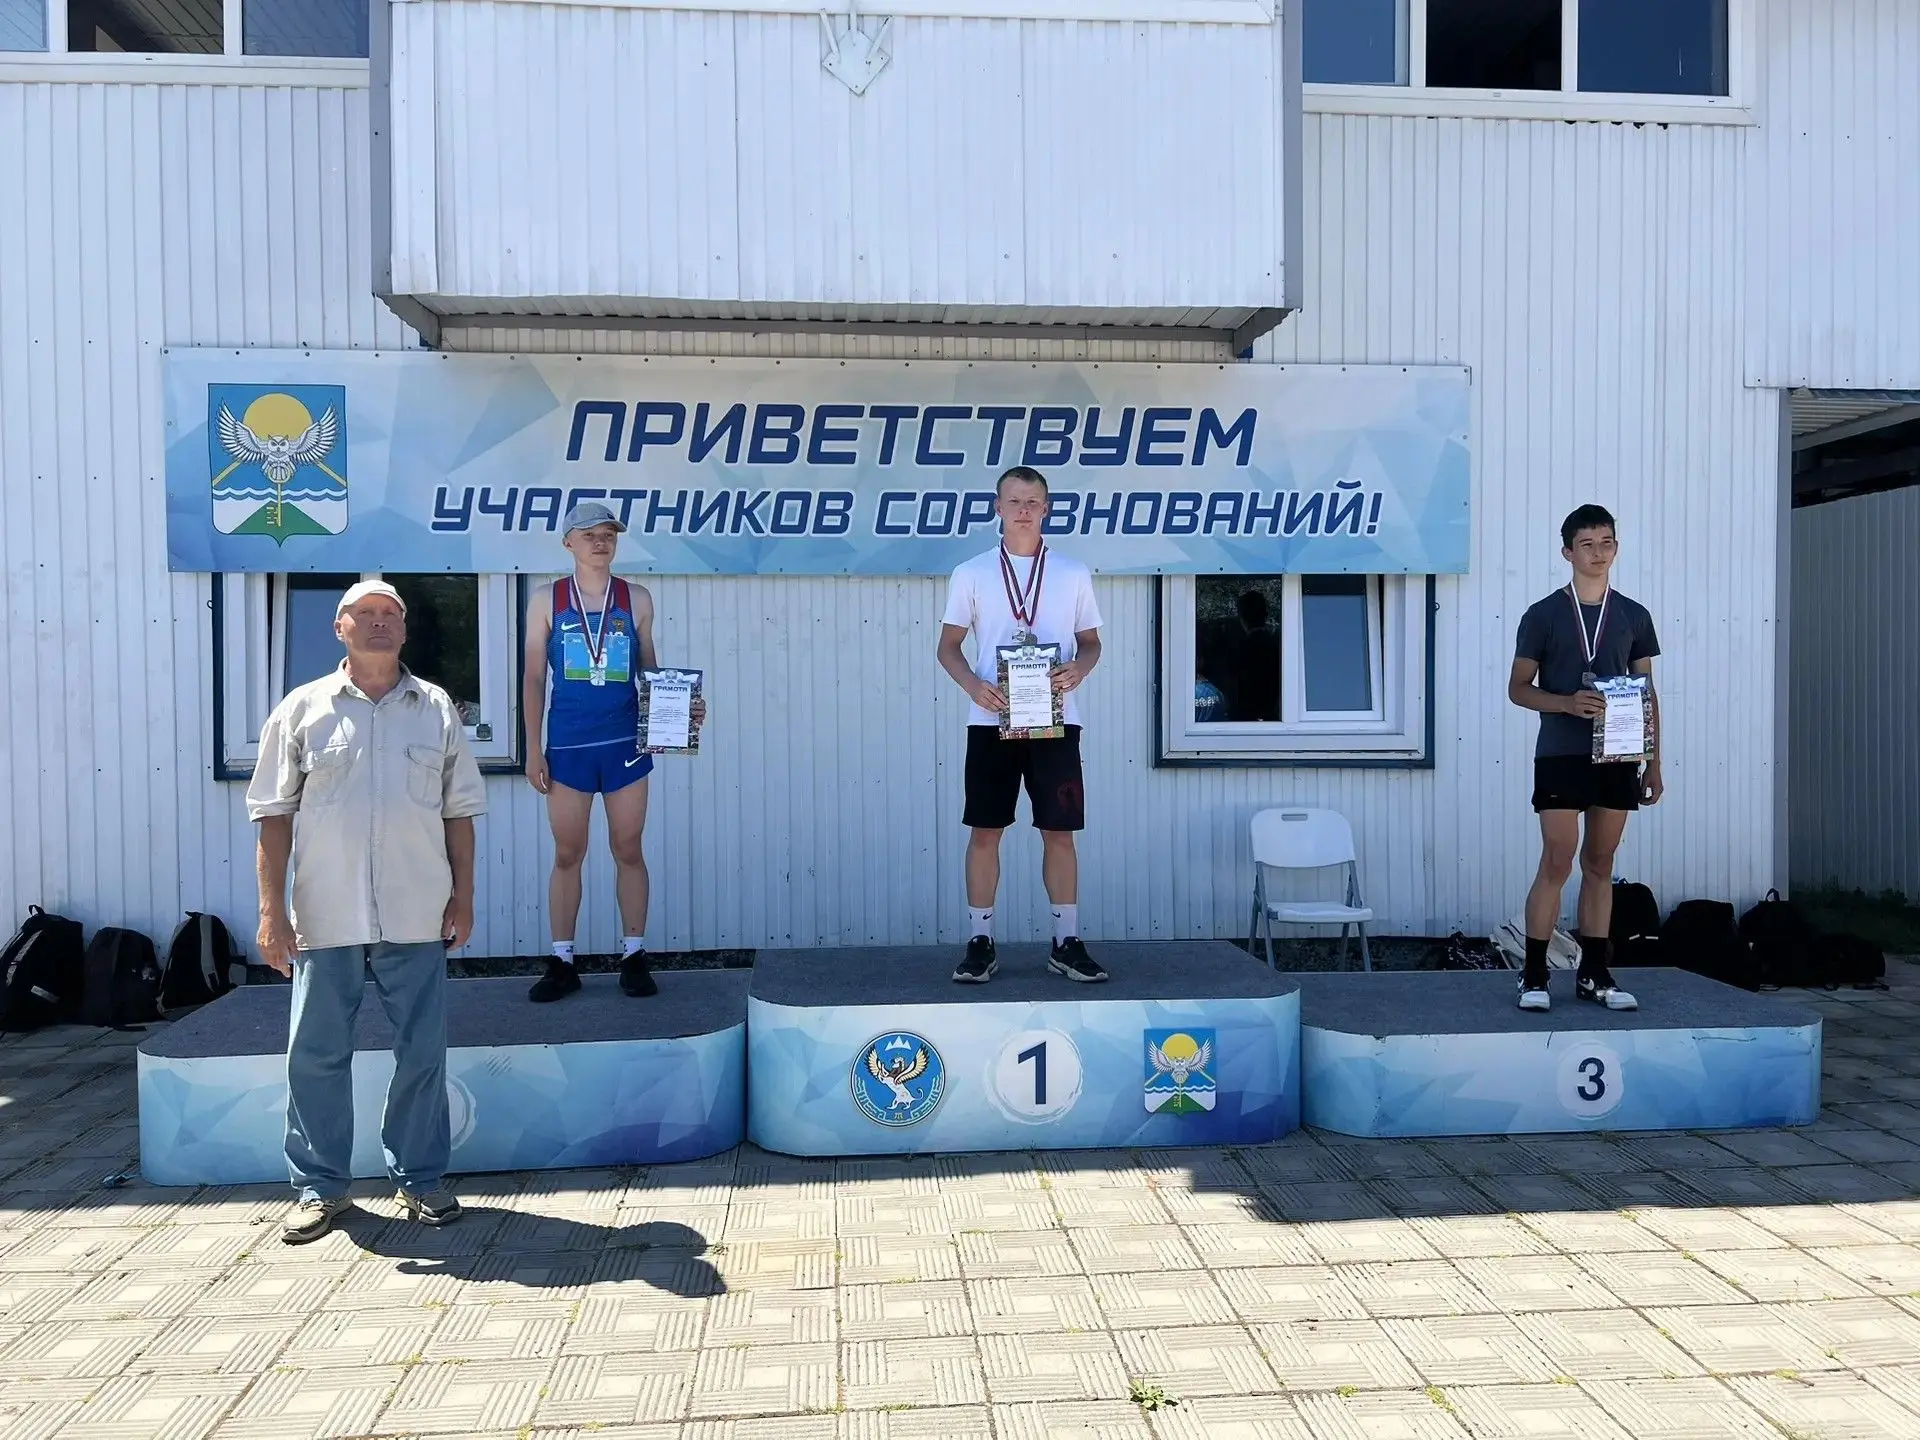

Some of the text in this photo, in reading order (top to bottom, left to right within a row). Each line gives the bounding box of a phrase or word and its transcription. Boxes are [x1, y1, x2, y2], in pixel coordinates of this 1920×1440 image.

[565, 401, 1258, 467] ПРИВЕТСТВУЕМ
[874, 480, 1382, 536] СОРВНОВАНИЙ!
[653, 685, 688, 693] ГРАМОТА
[1011, 662, 1047, 671] ГРАМОТА
[1607, 692, 1639, 700] ГРАМОТА
[1017, 1040, 1047, 1106] 1
[1576, 1056, 1606, 1102] 3
